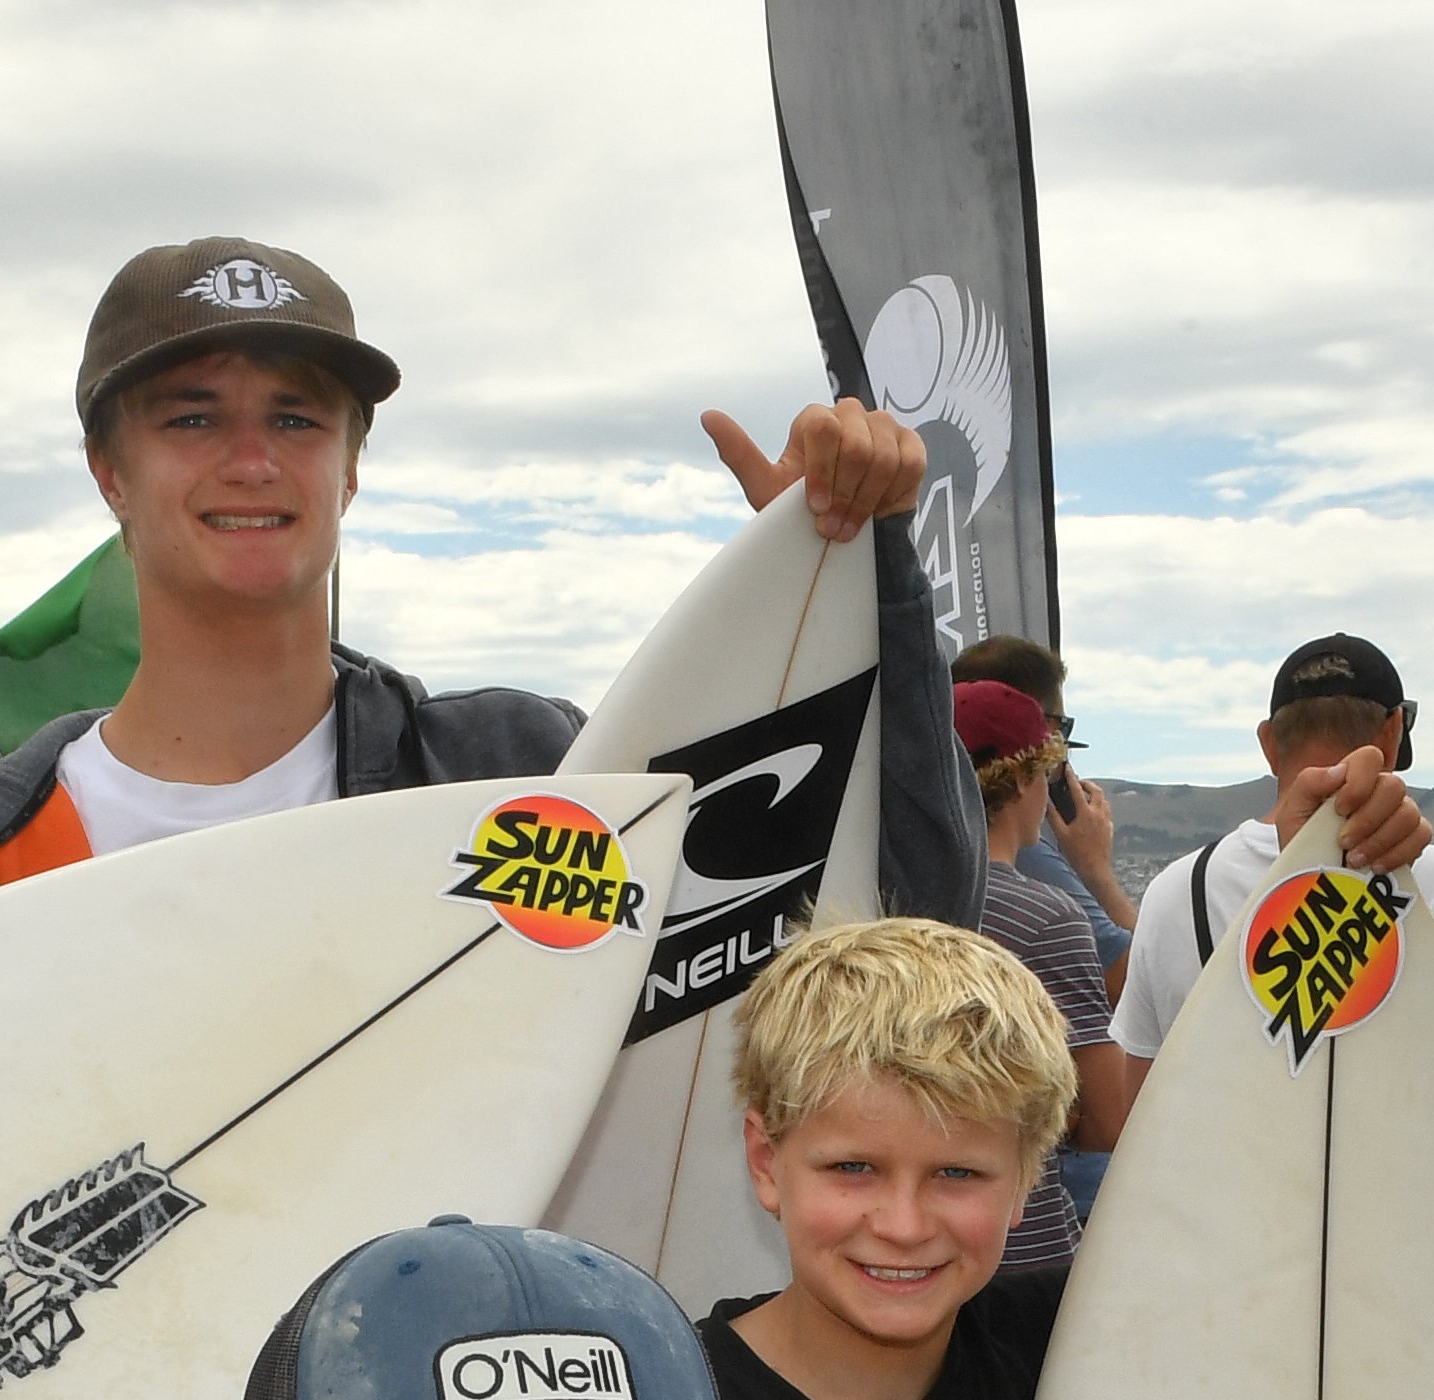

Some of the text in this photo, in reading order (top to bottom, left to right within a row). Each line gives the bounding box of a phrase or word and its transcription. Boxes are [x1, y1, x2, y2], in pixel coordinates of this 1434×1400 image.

[486, 810, 611, 872] SUN
[445, 851, 645, 931] ZAPPER
[1253, 873, 1348, 999] SUN
[644, 913, 801, 1013] NEILL
[1268, 872, 1411, 1068] ZAPPER
[452, 1346, 622, 1400] O'Neill
